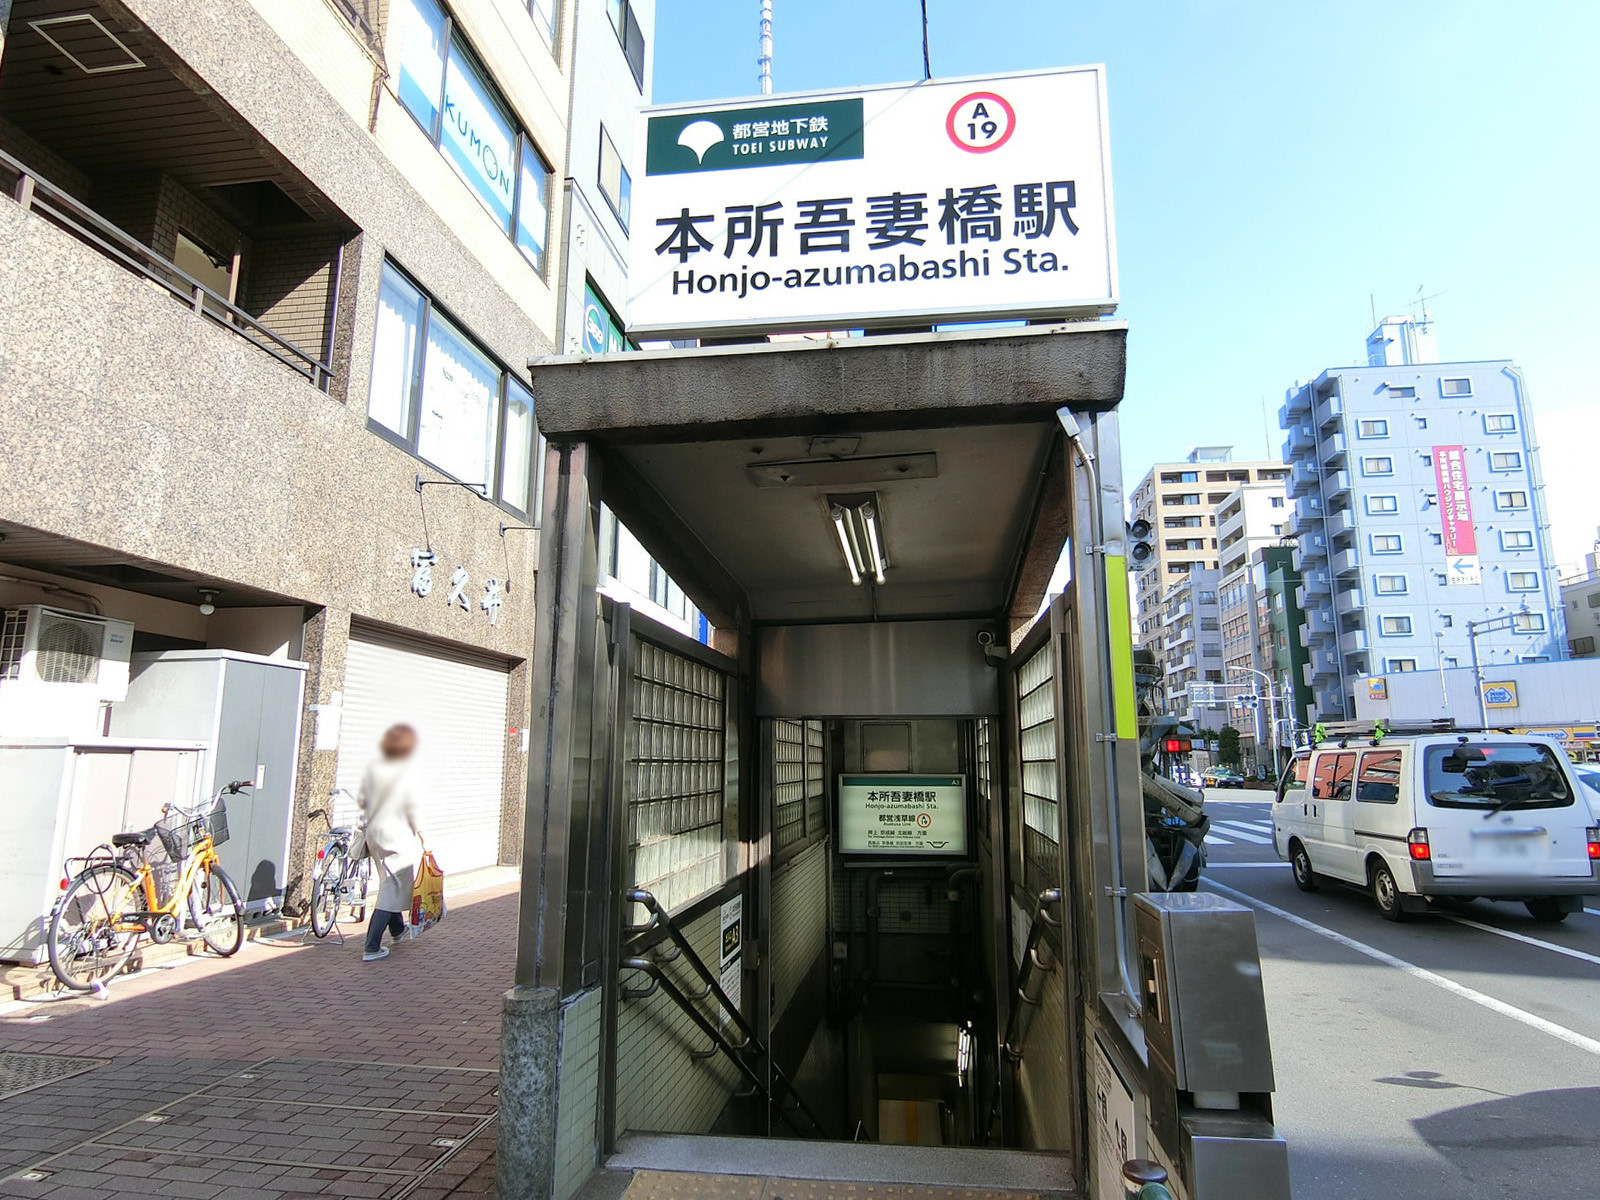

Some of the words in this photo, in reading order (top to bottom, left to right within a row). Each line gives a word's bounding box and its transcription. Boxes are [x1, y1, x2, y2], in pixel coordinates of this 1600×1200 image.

[972, 102, 990, 119] A
[732, 116, 829, 140] 都営地下鉄
[967, 121, 997, 140] 19
[445, 94, 509, 195] KUMON
[732, 143, 763, 156] TOEI
[769, 136, 829, 153] SUBWAY
[654, 179, 1080, 264] 本所吾妻橋駅
[672, 249, 990, 299] Honjo-azumabashi
[1003, 247, 1070, 276] Sta.
[867, 790, 937, 803] 本所吾妻橋駅
[865, 803, 925, 811] Honjo-azumabashi
[878, 814, 916, 823] 都営浅草線
